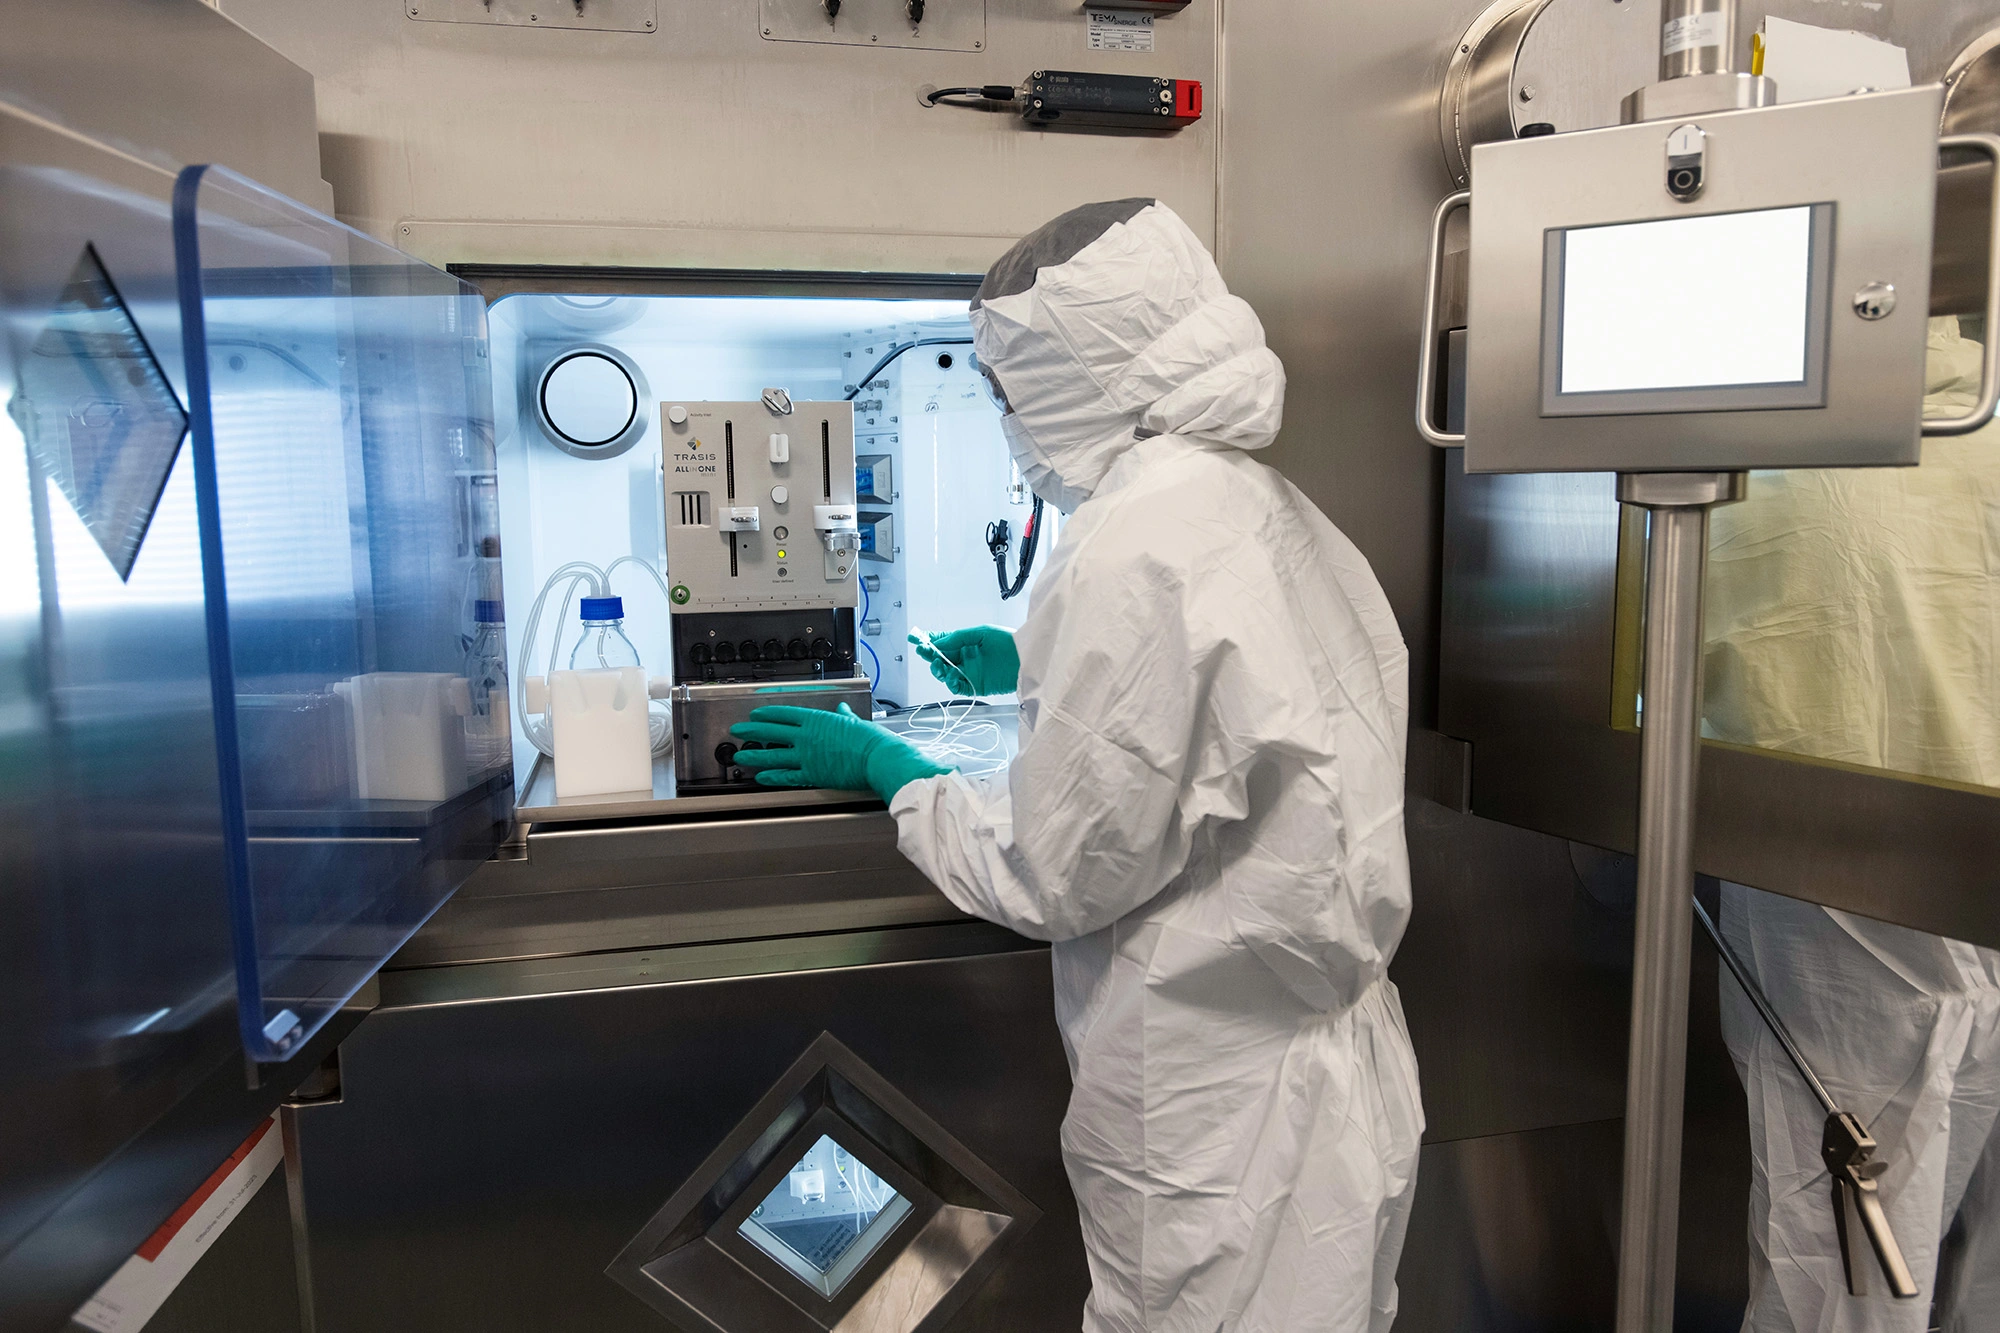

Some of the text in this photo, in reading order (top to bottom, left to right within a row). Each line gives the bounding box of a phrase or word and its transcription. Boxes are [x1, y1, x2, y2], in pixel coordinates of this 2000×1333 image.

[1090, 13, 1117, 22] TEMA
[912, 26, 920, 39] 2
[673, 453, 716, 461] TRASIS
